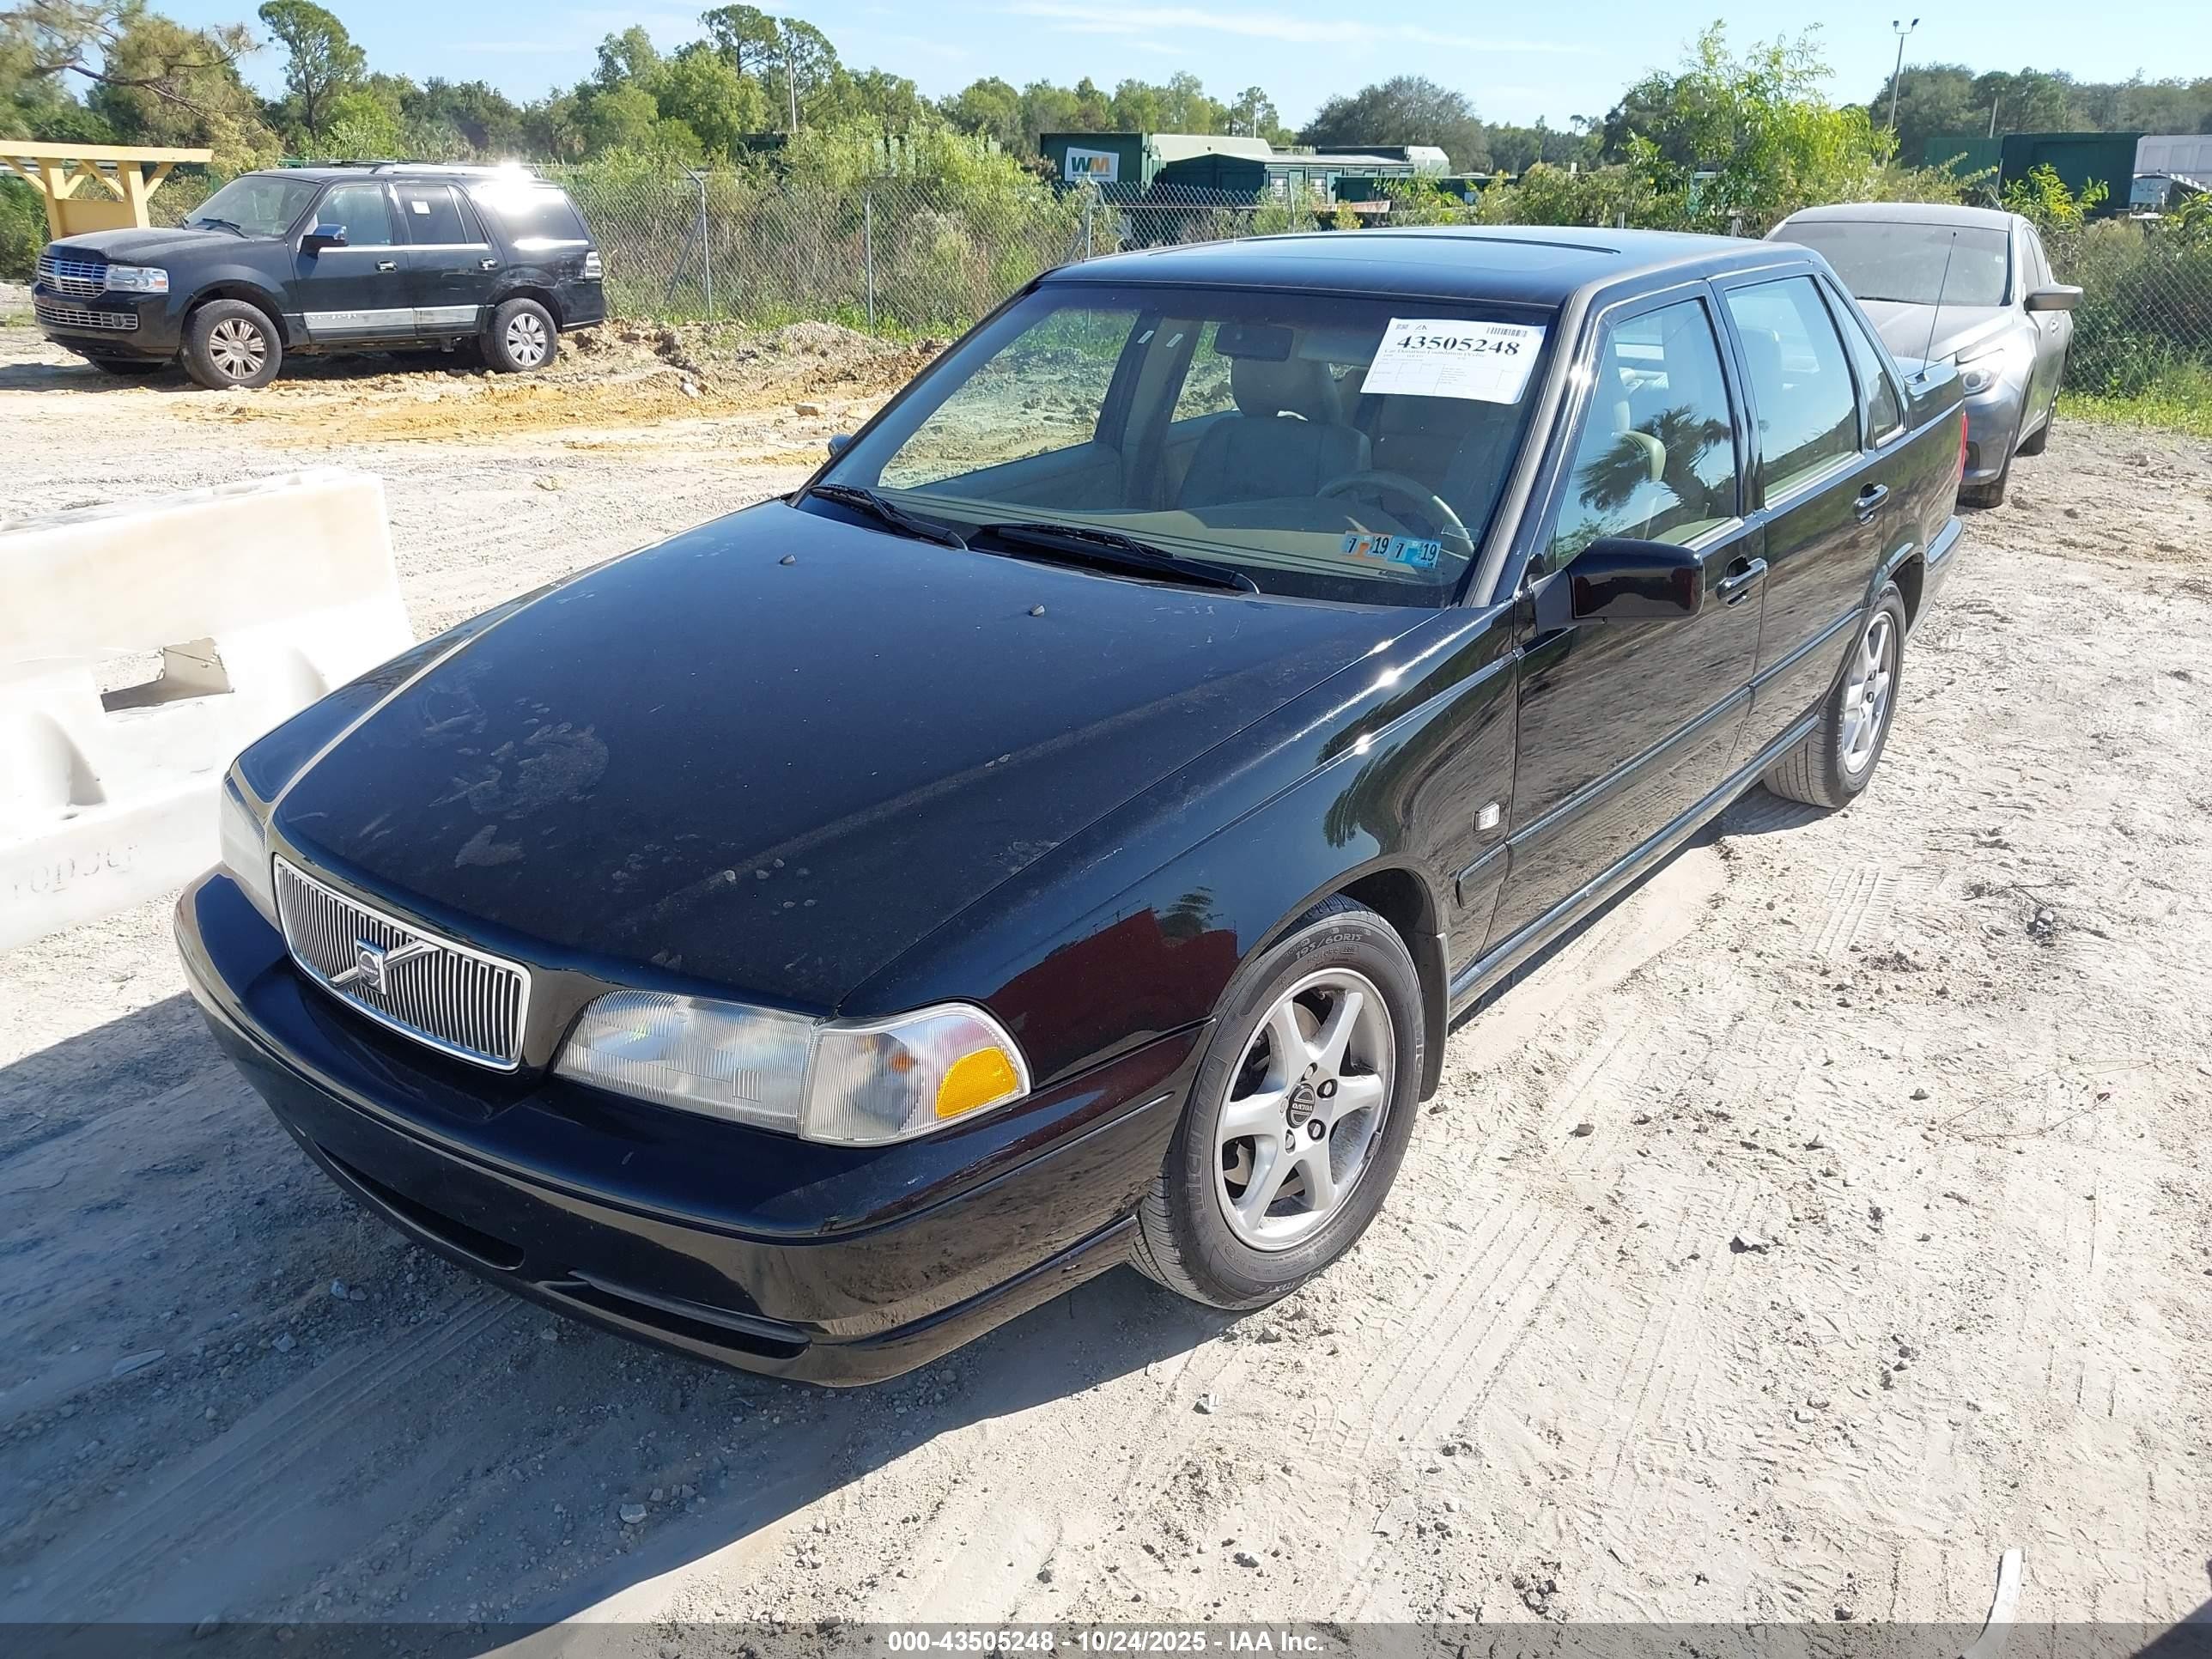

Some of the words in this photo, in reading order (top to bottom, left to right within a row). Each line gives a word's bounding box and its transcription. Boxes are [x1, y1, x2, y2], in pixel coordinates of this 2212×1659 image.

[1072, 157, 1109, 172] WM
[1397, 336, 1520, 356] 43505248
[1348, 538, 1358, 553] 7
[1372, 537, 1389, 555] 19
[1395, 543, 1405, 558] 7
[1420, 544, 1437, 562] 19
[1295, 933, 1363, 959] 195/60R15
